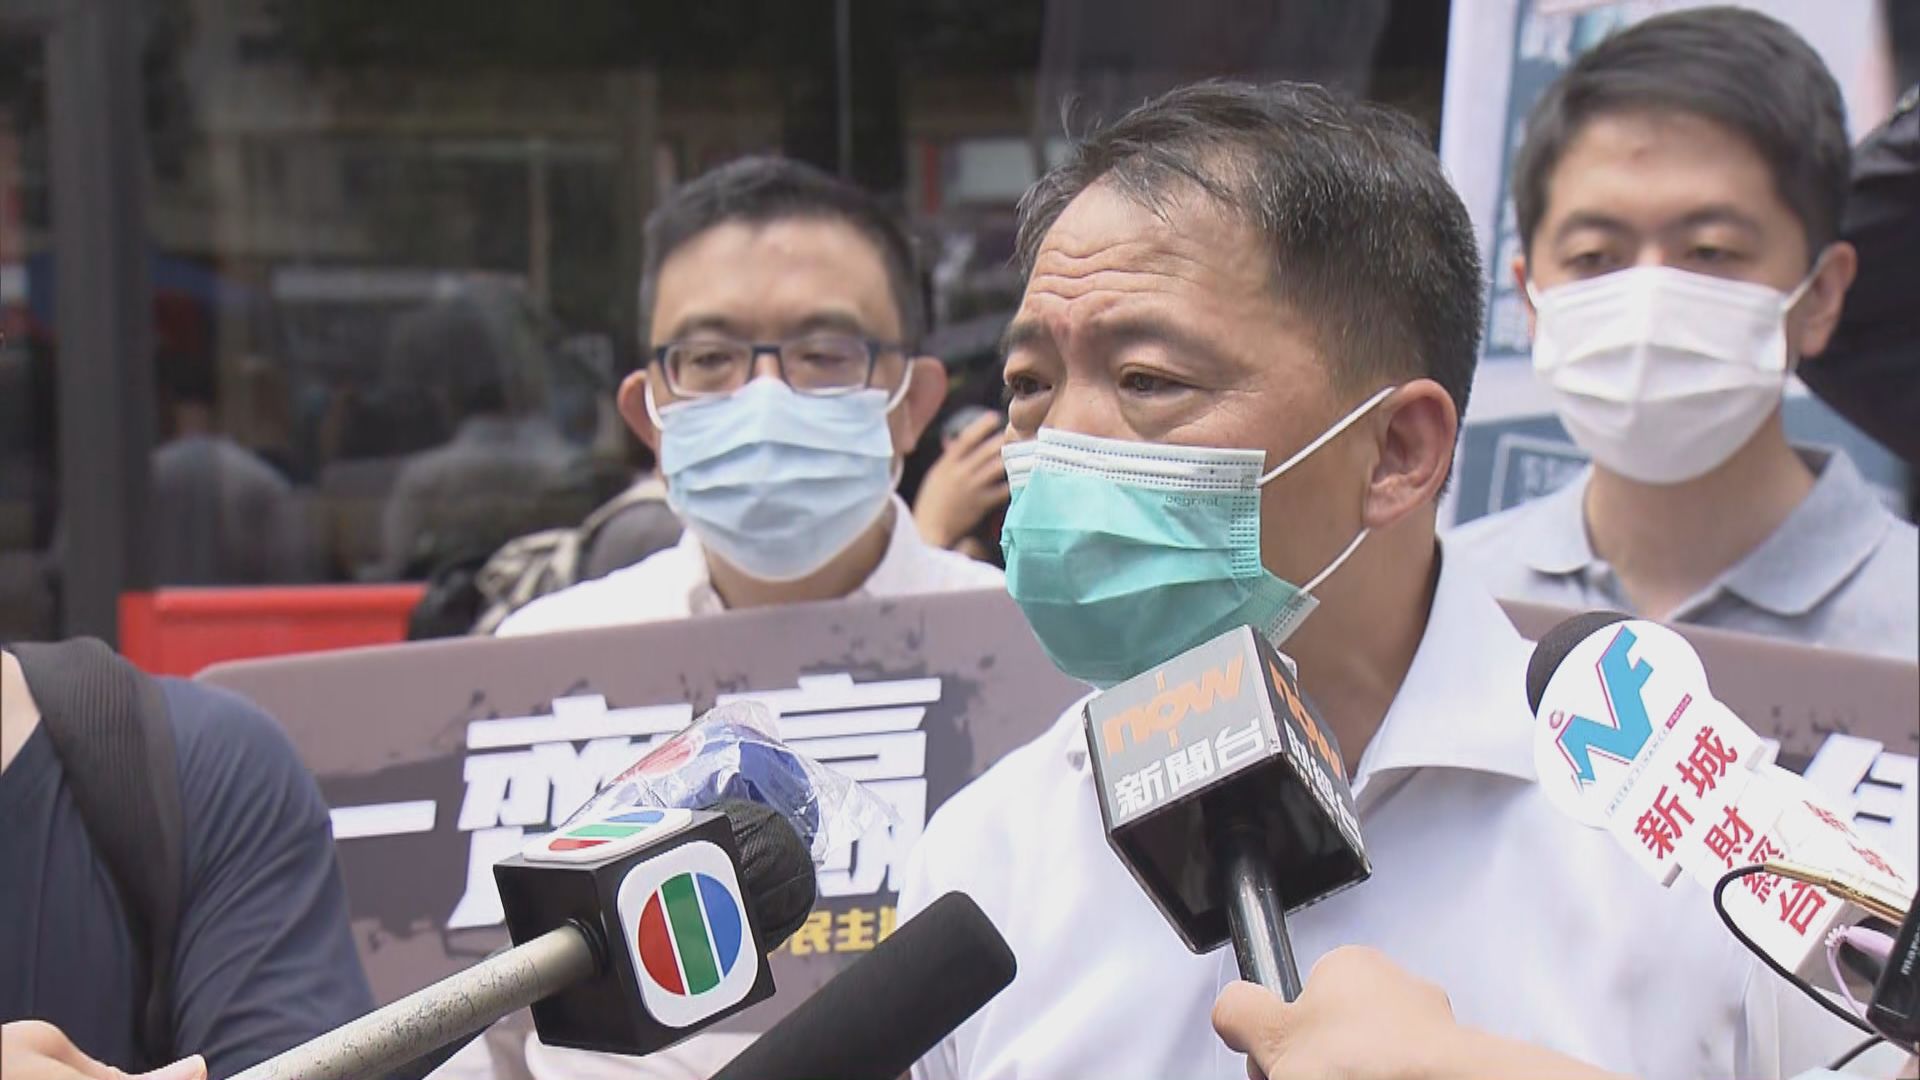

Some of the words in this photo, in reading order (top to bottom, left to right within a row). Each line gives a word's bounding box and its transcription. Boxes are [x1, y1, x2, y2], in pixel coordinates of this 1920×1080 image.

[1102, 655, 1244, 757] now
[1269, 660, 1342, 781] now
[1115, 718, 1266, 816] 新聞台
[1634, 726, 1738, 860] 新城
[1703, 805, 1827, 936] 財經台
